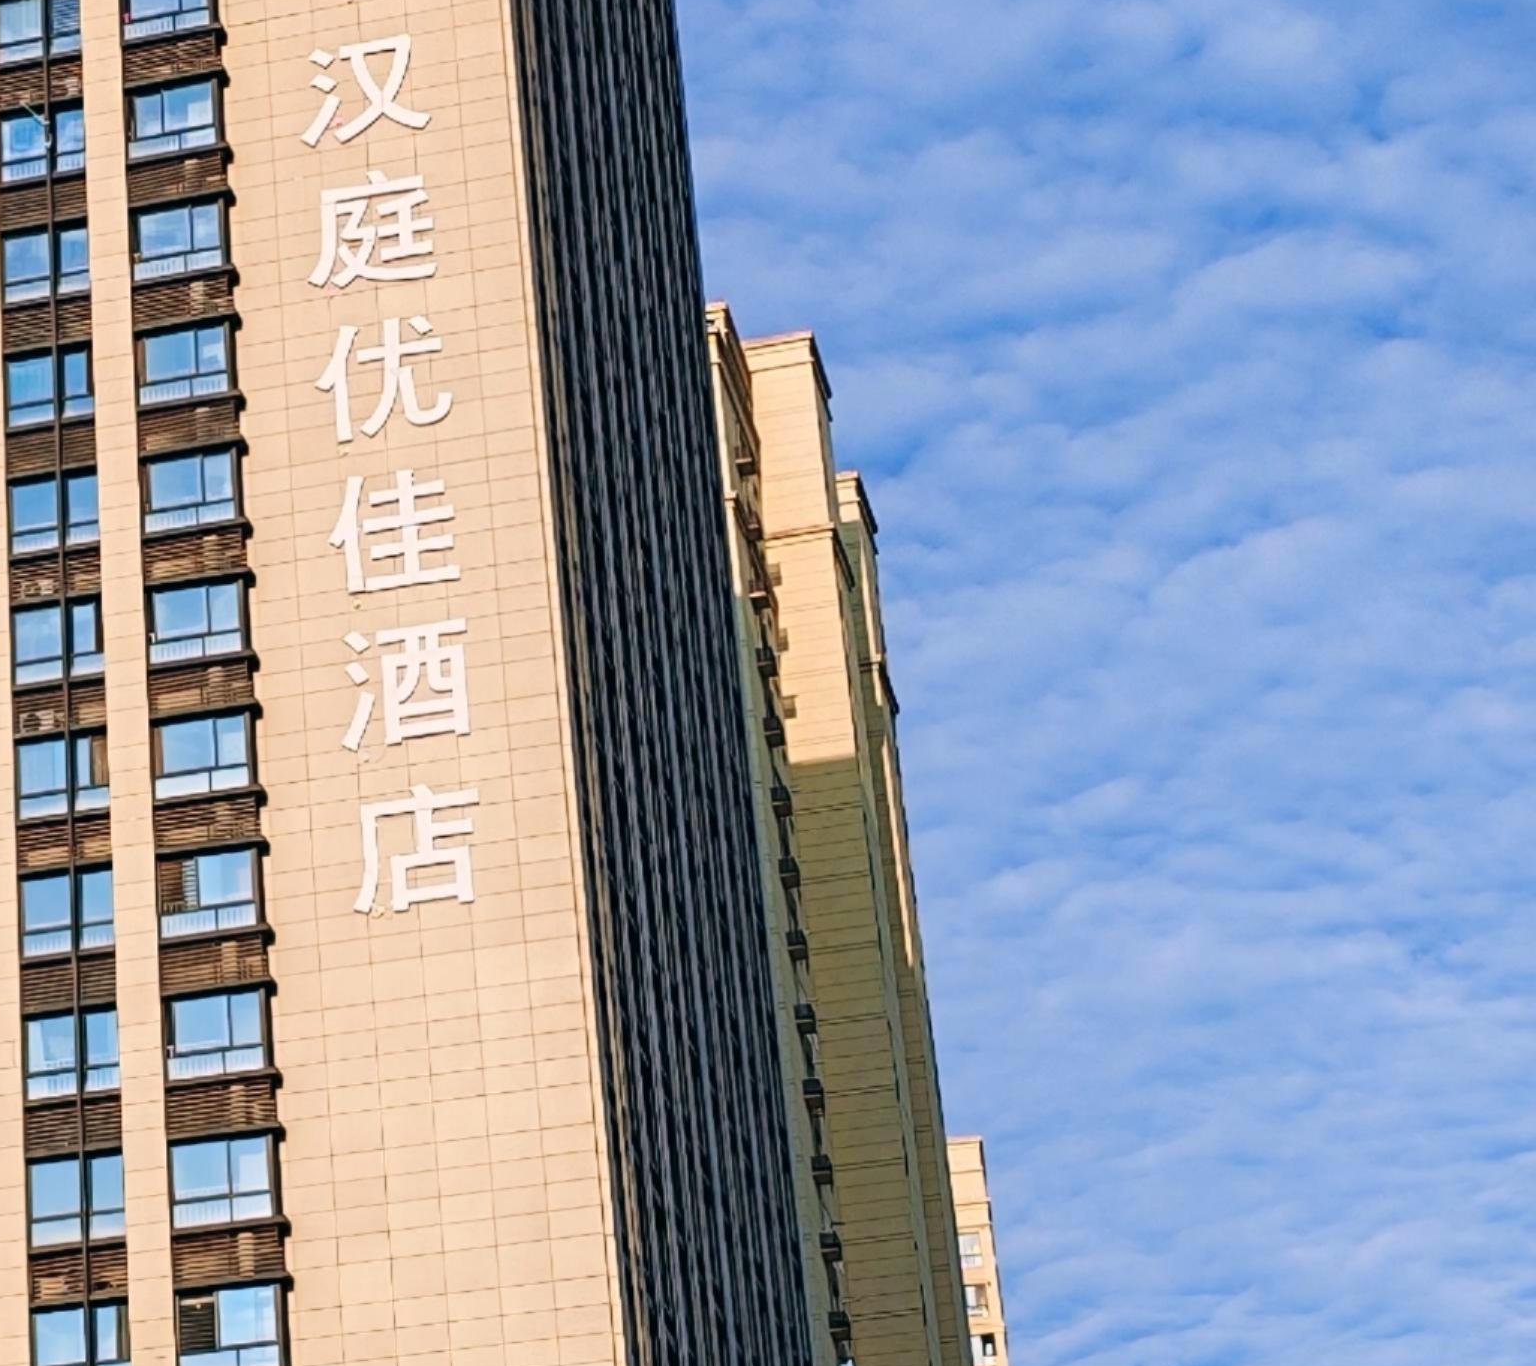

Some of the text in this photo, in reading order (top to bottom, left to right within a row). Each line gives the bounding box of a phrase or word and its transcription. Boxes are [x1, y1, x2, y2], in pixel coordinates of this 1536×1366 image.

[301, 34, 480, 913] 汉庭优佳酒店
